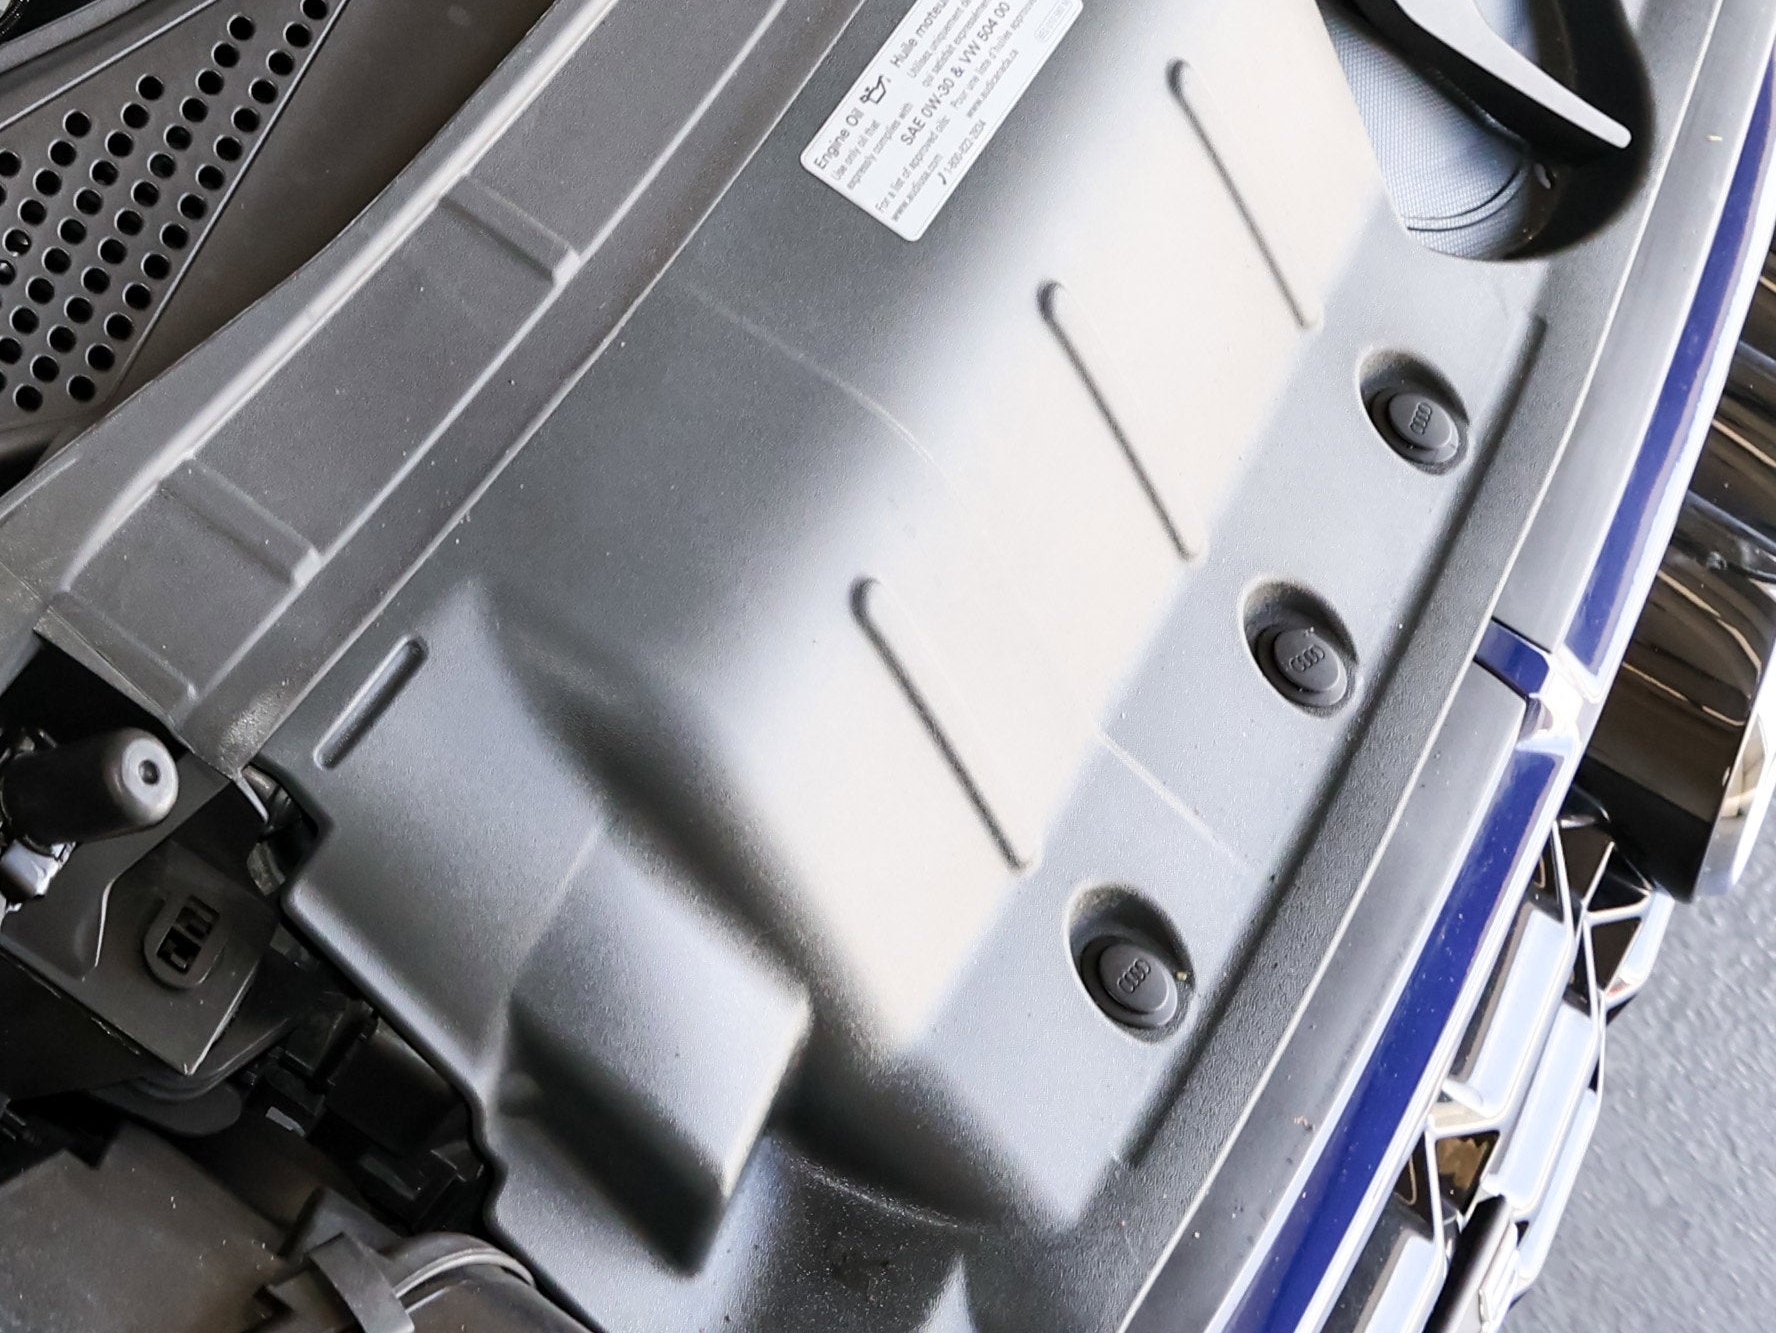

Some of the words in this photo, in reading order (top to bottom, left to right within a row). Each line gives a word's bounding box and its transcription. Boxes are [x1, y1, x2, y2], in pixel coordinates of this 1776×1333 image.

[891, 37, 916, 66] Huile
[901, 118, 924, 145] SAE
[922, 78, 954, 117] 0W-30
[951, 65, 963, 77] &
[960, 41, 981, 64] VW
[977, 18, 998, 40] 504
[993, 1, 1010, 18] 00
[814, 127, 850, 170] Engine
[845, 107, 863, 127] Oil
